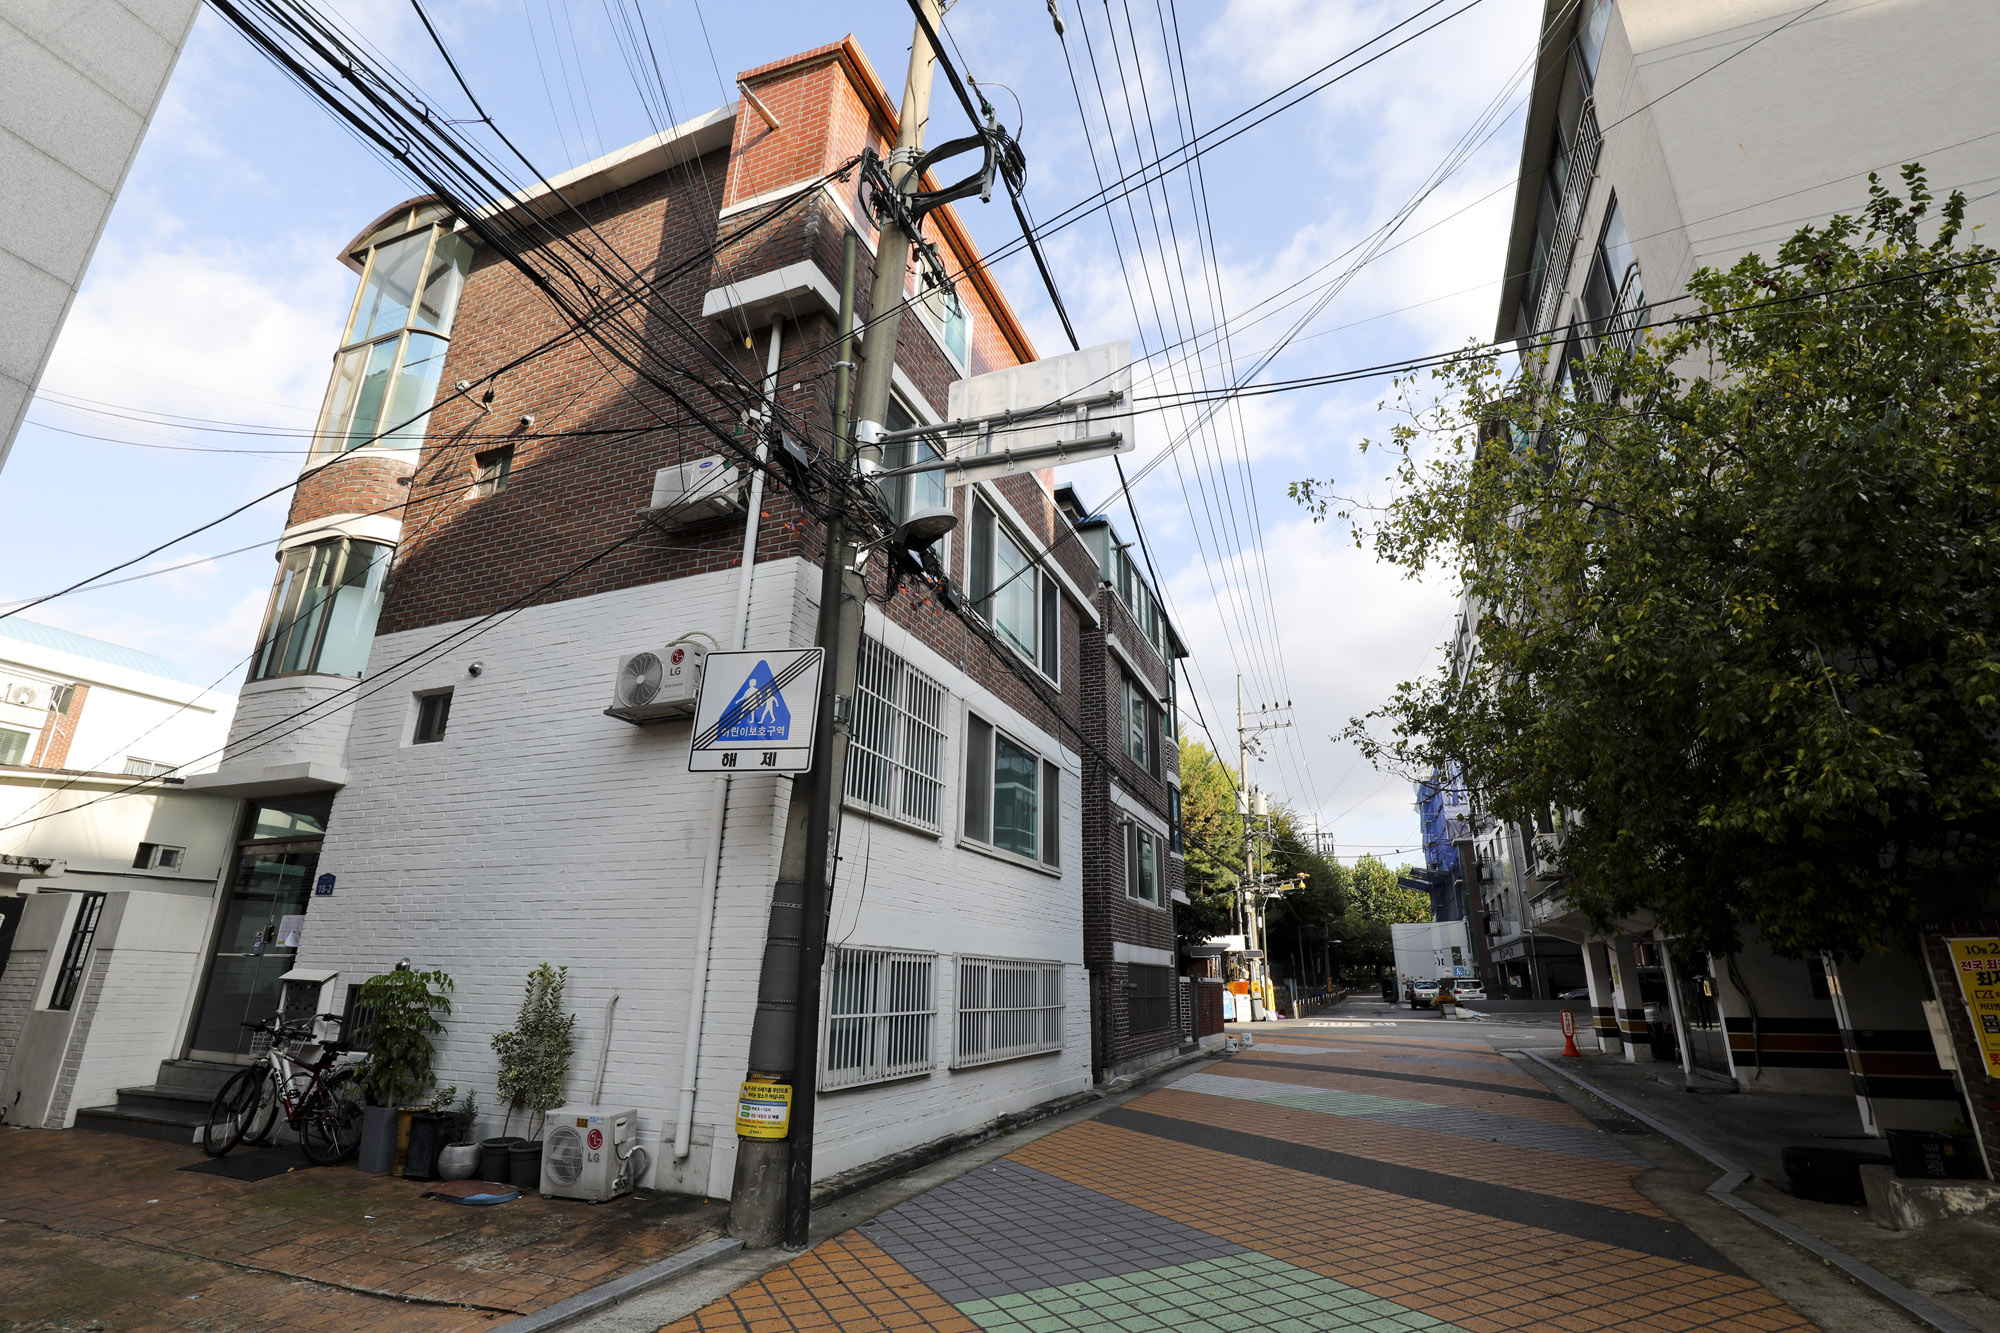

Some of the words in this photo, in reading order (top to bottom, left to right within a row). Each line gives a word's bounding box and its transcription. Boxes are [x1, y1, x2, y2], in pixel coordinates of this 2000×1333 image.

[670, 666, 681, 676] LG
[721, 726, 785, 738] 어린이보호구역
[318, 884, 332, 893] 18-2
[1960, 959, 1984, 972] 전국
[1986, 958, 2000, 969] 최
[587, 1152, 600, 1163] LG
